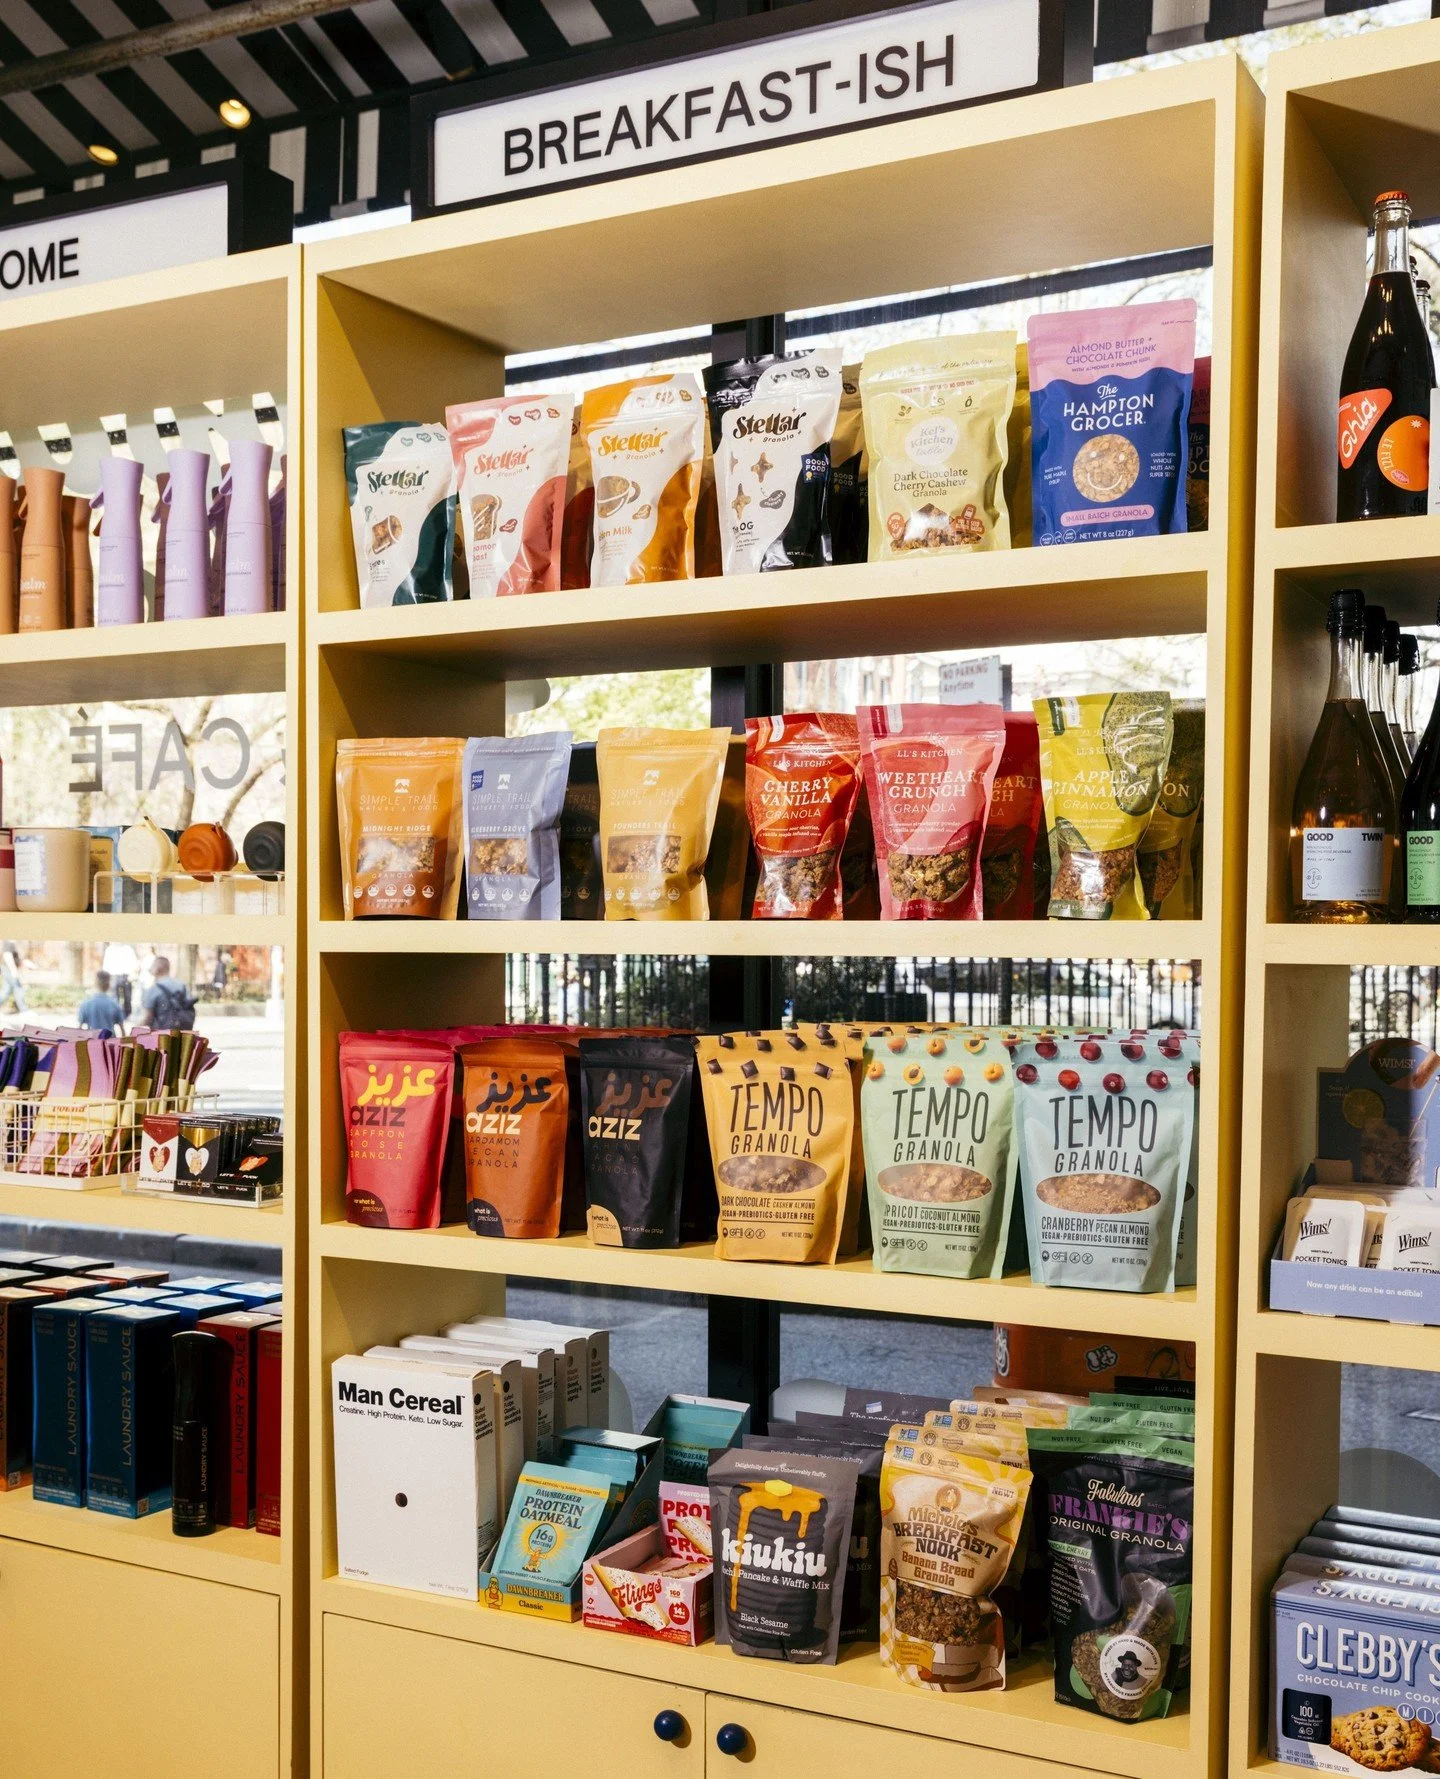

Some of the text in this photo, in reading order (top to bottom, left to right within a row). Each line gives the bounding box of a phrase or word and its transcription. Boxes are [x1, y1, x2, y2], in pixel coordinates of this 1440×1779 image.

[504, 35, 954, 177] BREAKFAST-ISH
[0, 237, 79, 290] OME
[1070, 337, 1145, 354] ALMOND BUTTER
[1066, 344, 1157, 366] CHOCOLATE CHUNK
[1097, 384, 1118, 398] The
[1063, 394, 1154, 417] HAMPTON
[733, 412, 807, 439] Stellar
[1341, 397, 1379, 458] Ghia
[598, 431, 668, 457] Stellar
[763, 434, 794, 443] granola
[474, 448, 534, 474] Stellar
[626, 451, 656, 460] granola
[367, 470, 429, 493] Stellar
[894, 468, 968, 482] Dark Chocolate
[893, 479, 967, 492] Cherry Cashew
[912, 489, 947, 498] Granola
[1087, 509, 1148, 520] BATCH GRANOLA
[613, 527, 632, 536] Milk
[740, 521, 754, 530] OG
[955, 663, 988, 677] PARKING
[897, 748, 963, 758] LL'S KITCHEN
[1076, 748, 1094, 756] LL'S
[794, 759, 833, 767] KITCHEN
[764, 777, 834, 793] CHERRY
[1073, 770, 1128, 784] APPLE
[472, 792, 535, 804] SIMPLE TRAIL
[611, 788, 647, 799] SIMPLE
[760, 791, 832, 806] VANILLA
[888, 784, 966, 799] CRUNCH
[1052, 782, 1150, 798] CINNAMON
[360, 794, 439, 805] SIMPLE TRAIL
[893, 803, 957, 814] GRANOLA
[1063, 799, 1124, 811] GRANOLA
[765, 808, 821, 819] GRANOLA
[1307, 832, 1383, 842] GOOD TWIN
[1409, 836, 1434, 845] GOOD
[357, 1064, 436, 1107] عزيز
[476, 1071, 552, 1113] عزيز
[595, 1072, 673, 1118] عزيز
[351, 1106, 406, 1127] aziz
[730, 1081, 824, 1137] TEMPO
[892, 1086, 989, 1144] TEMPO
[465, 1112, 521, 1135] aziz
[588, 1116, 642, 1140] aziz
[1048, 1094, 1157, 1153] TEMPO
[731, 1133, 812, 1159] GRANOLA
[893, 1140, 975, 1167] GRANOLA
[1055, 1149, 1143, 1177] GRANOLA
[721, 1195, 815, 1209] DARK CHOCOLATE CASHEW ALMOND
[800, 1212, 815, 1220] FREE
[920, 1210, 950, 1221] COCONUT
[952, 1212, 980, 1223] ALMOND
[964, 1224, 980, 1233] FREE
[1041, 1216, 1149, 1236] CRANBERRY PECAN ALMOND
[1300, 1219, 1331, 1240] Wims!
[1132, 1236, 1149, 1246] FREE
[1398, 1232, 1432, 1253] Wims!
[1322, 1257, 1347, 1266] TONICS
[1306, 1280, 1322, 1289] Now
[1324, 1283, 1337, 1292] any
[1339, 1282, 1357, 1291] drink
[1358, 1285, 1372, 1293] can
[1374, 1285, 1383, 1294] be
[1397, 1288, 1423, 1298] edible!
[67, 1318, 78, 1456] LAUNDRY SAUCE
[338, 1381, 383, 1405] Man
[121, 1326, 133, 1467] LAUNDRY SAUCE
[235, 1333, 247, 1475] LAUNDRY SAUCE
[339, 1405, 464, 1428] Creatine. High Protein. Keto. Low Sugar.
[1102, 1438, 1143, 1449] GLUTEN FREE
[1161, 1447, 1183, 1456] VEGAN
[735, 1461, 827, 1478] Delightfully chewy. Unbelievably fluffy.
[536, 1488, 582, 1503] DAWNBREAKER
[992, 1486, 1014, 1499] NEW!
[1087, 1478, 1144, 1508] Fabulous
[524, 1496, 584, 1516] PROTEIN
[520, 1508, 582, 1529] OATMEAL
[908, 1507, 979, 1534] Michele's
[1049, 1494, 1188, 1541] FRANKIE'S
[535, 1528, 553, 1543] 16g
[893, 1523, 999, 1560] BREAKFAST
[1050, 1515, 1185, 1553] ORIGINAL GRANOLA
[531, 1539, 552, 1548] PROTEIN
[721, 1527, 827, 1577] kiukiu
[915, 1537, 961, 1562] NOOK
[1066, 1546, 1089, 1557] CHERRY
[902, 1551, 975, 1579] Banana Bread
[738, 1569, 830, 1590] Pancake & Waffle Mix
[913, 1566, 955, 1587] Granola
[506, 1584, 564, 1602] DAWNBREAKER
[612, 1579, 662, 1612] Flings
[519, 1600, 544, 1611] Classic
[740, 1613, 788, 1629] Black Sesame
[1297, 1673, 1368, 1692] CHOCOLATE
[1372, 1686, 1401, 1697] CHIP
[1300, 1706, 1313, 1717] 100
